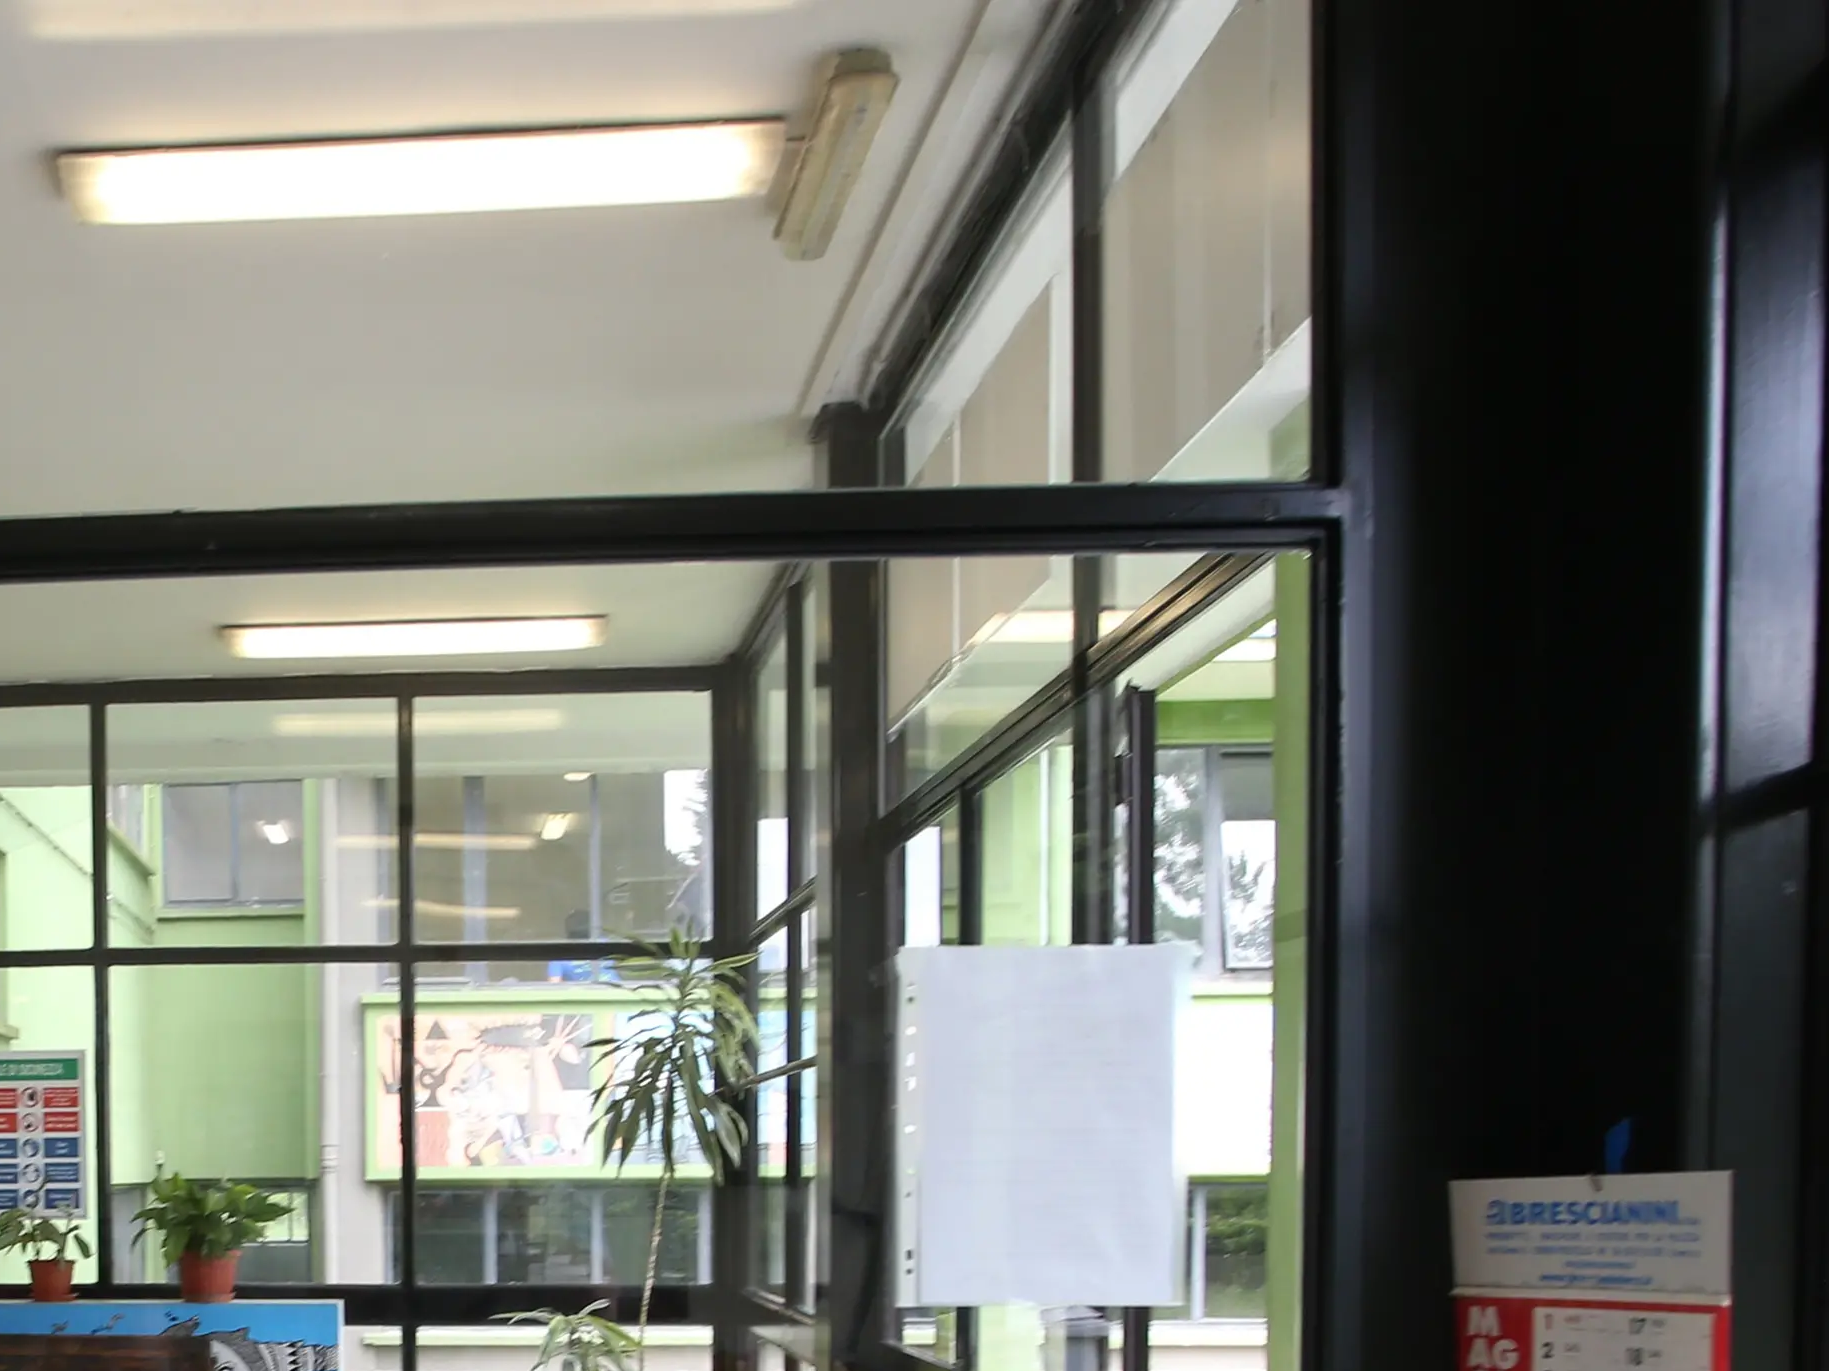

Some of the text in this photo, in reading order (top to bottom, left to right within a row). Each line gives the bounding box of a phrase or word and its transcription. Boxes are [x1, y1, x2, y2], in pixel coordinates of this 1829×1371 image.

[1467, 1306, 1501, 1336] M
[1544, 1313, 1554, 1331] 1
[1628, 1317, 1647, 1335] 17
[1540, 1342, 1554, 1359] 2
